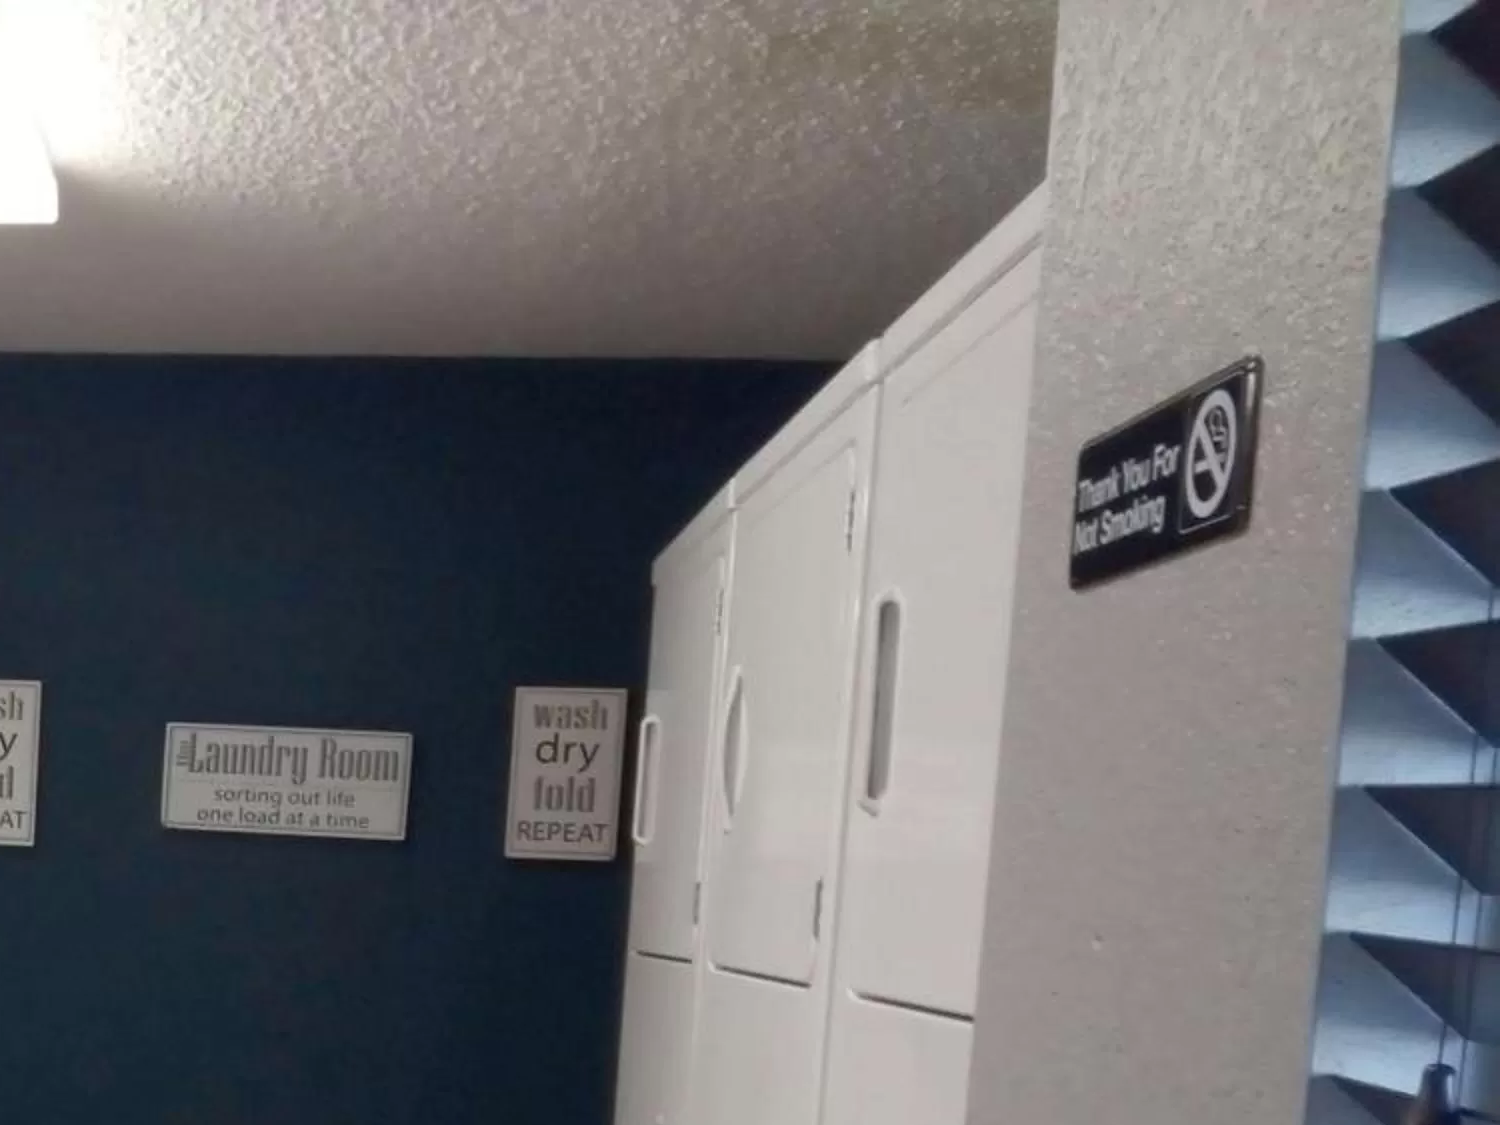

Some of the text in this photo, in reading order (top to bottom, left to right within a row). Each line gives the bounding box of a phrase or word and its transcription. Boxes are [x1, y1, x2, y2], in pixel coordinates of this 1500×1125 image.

[1079, 442, 1181, 513] Thank You For
[1075, 495, 1166, 555] Not Smoking
[533, 700, 609, 731] wash
[188, 732, 309, 785] Laundry
[317, 737, 400, 782] Room
[535, 732, 600, 774] dry
[214, 788, 356, 808] sorting out life
[197, 808, 233, 822] one
[239, 807, 280, 825] load
[286, 812, 304, 826] at
[326, 812, 370, 829] time
[517, 820, 610, 843] REPEAT
